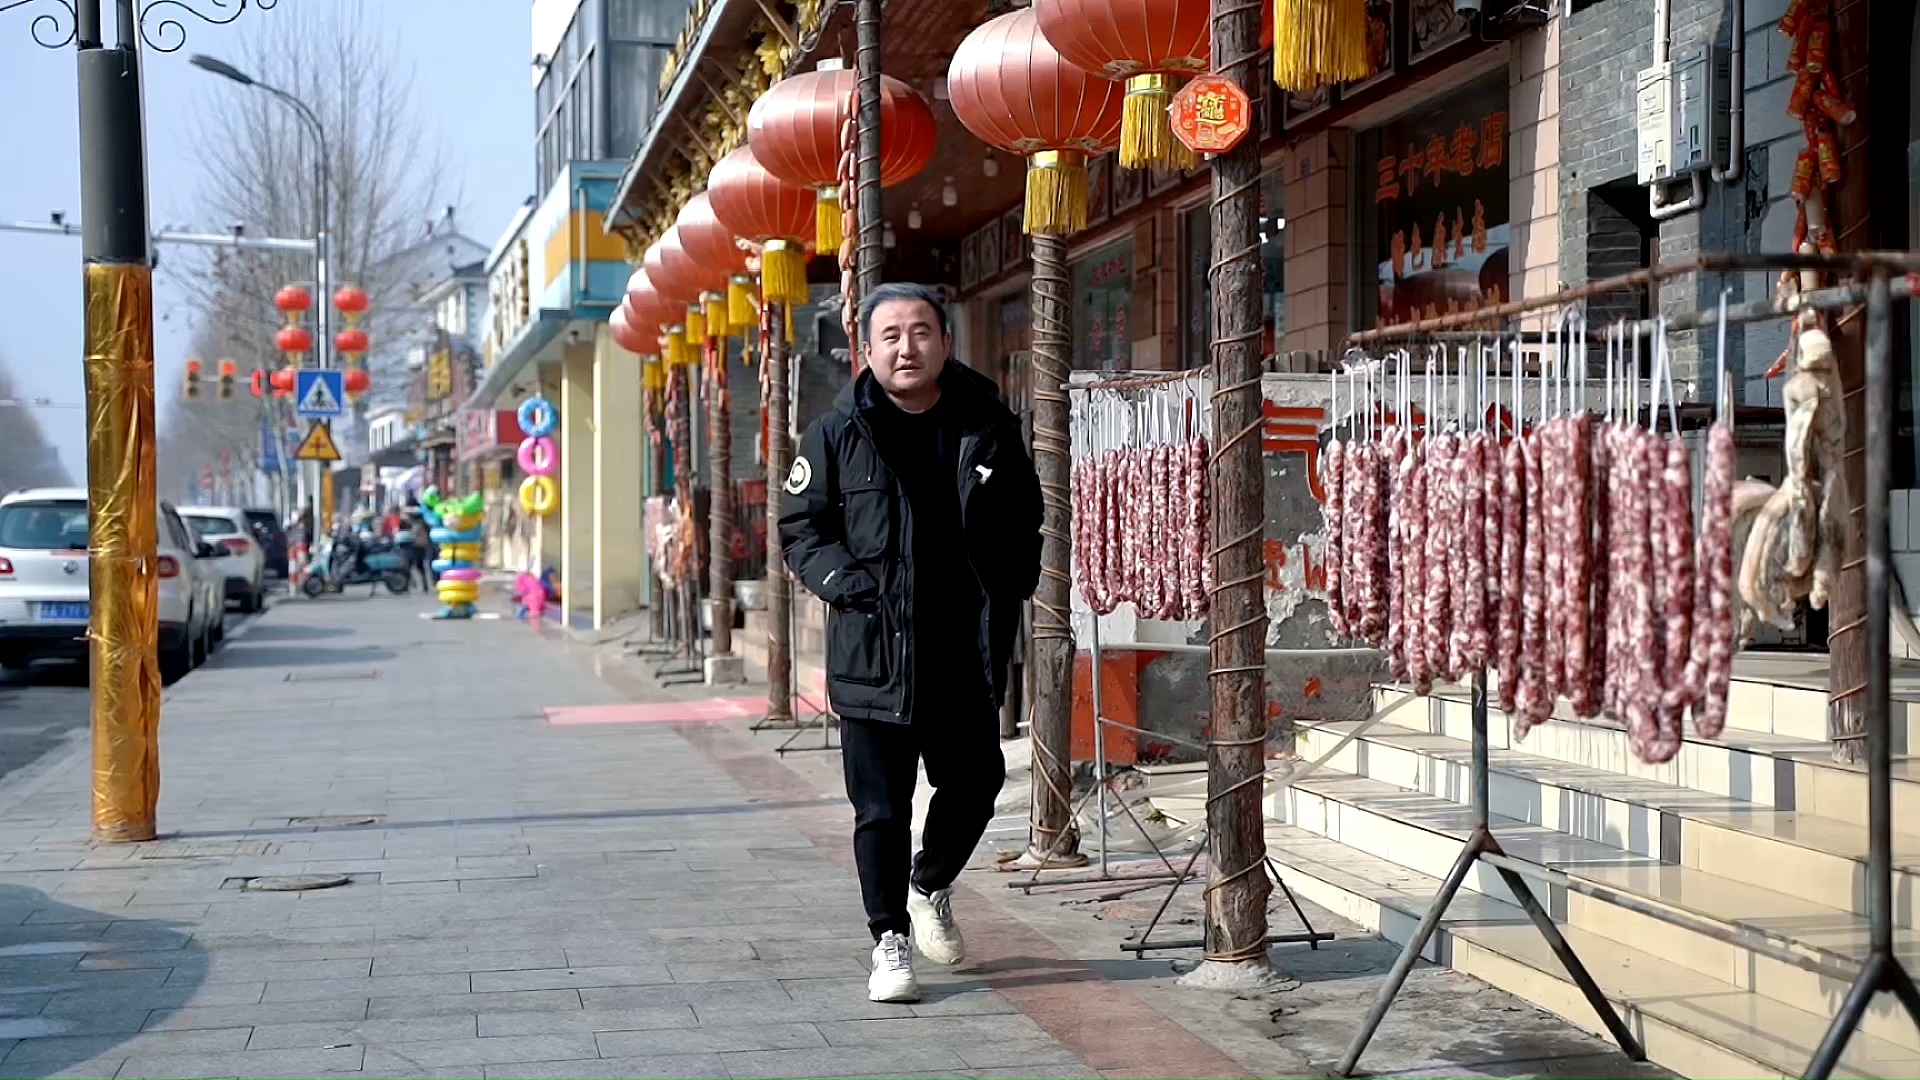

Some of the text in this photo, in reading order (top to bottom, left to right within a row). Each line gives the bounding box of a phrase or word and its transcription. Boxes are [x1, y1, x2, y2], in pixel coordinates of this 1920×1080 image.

[1376, 112, 1506, 203] 三十年老店
